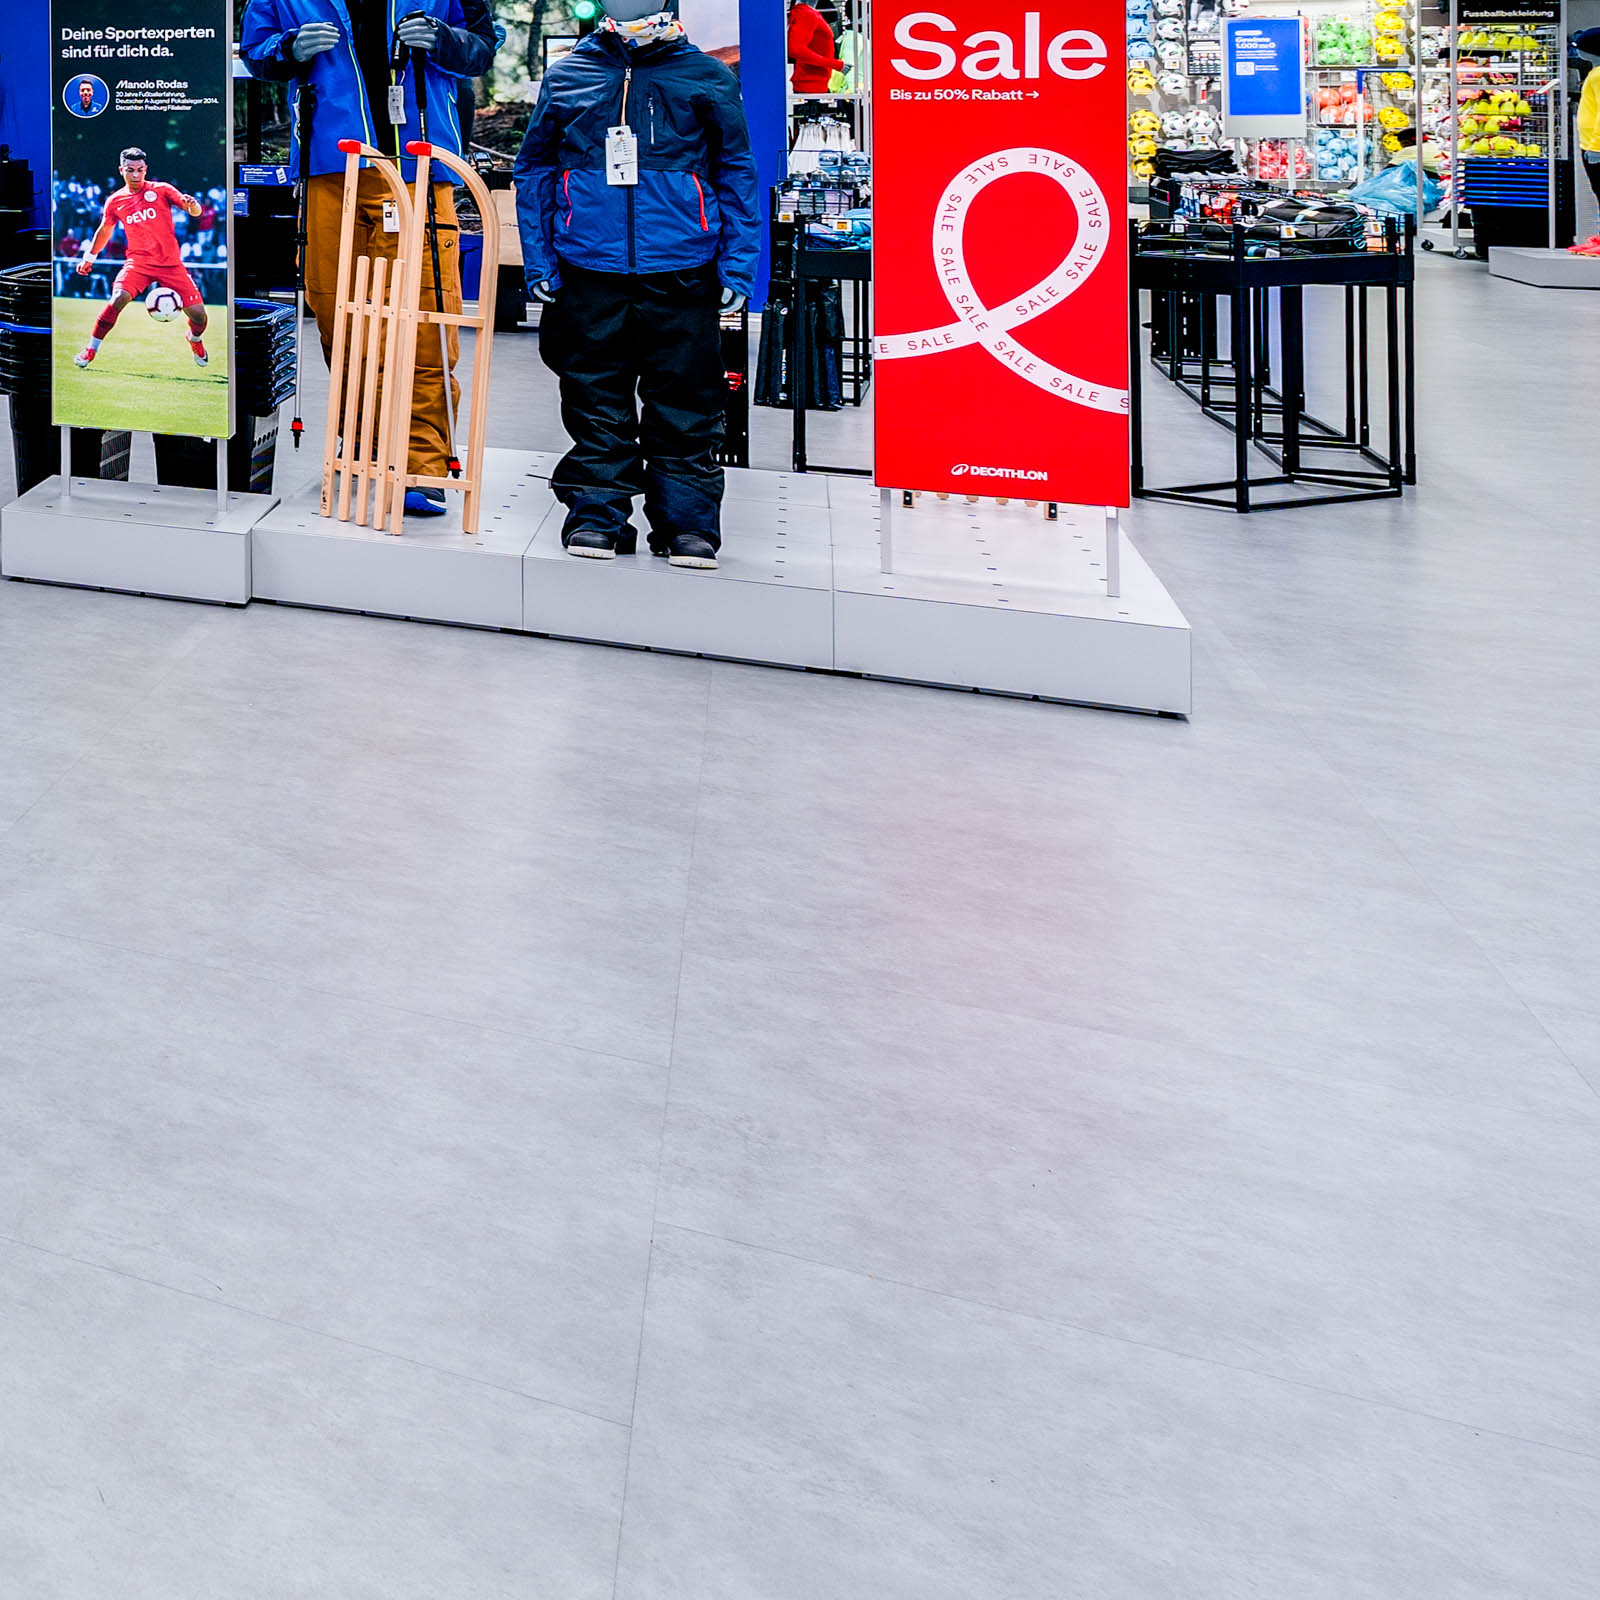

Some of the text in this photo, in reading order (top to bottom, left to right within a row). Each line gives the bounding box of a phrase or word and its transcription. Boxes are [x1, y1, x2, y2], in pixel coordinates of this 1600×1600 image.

[1463, 9, 1555, 18] Fussballbekleidung
[61, 26, 215, 42] Deine Sportexperten
[61, 44, 174, 58] sind für dich da.
[890, 11, 1108, 81] Sale
[115, 79, 189, 89] Manolo Rodas
[170, 97, 203, 105] Pokalsieger
[890, 88, 1024, 101] Bis zu 50% Rabatt
[144, 104, 167, 112] Freiburg
[907, 153, 1102, 402] SALE SALE SALE SALE SALE SALE SALE SALE SALE SALE SALE
[970, 465, 1048, 481] DECATHLON
